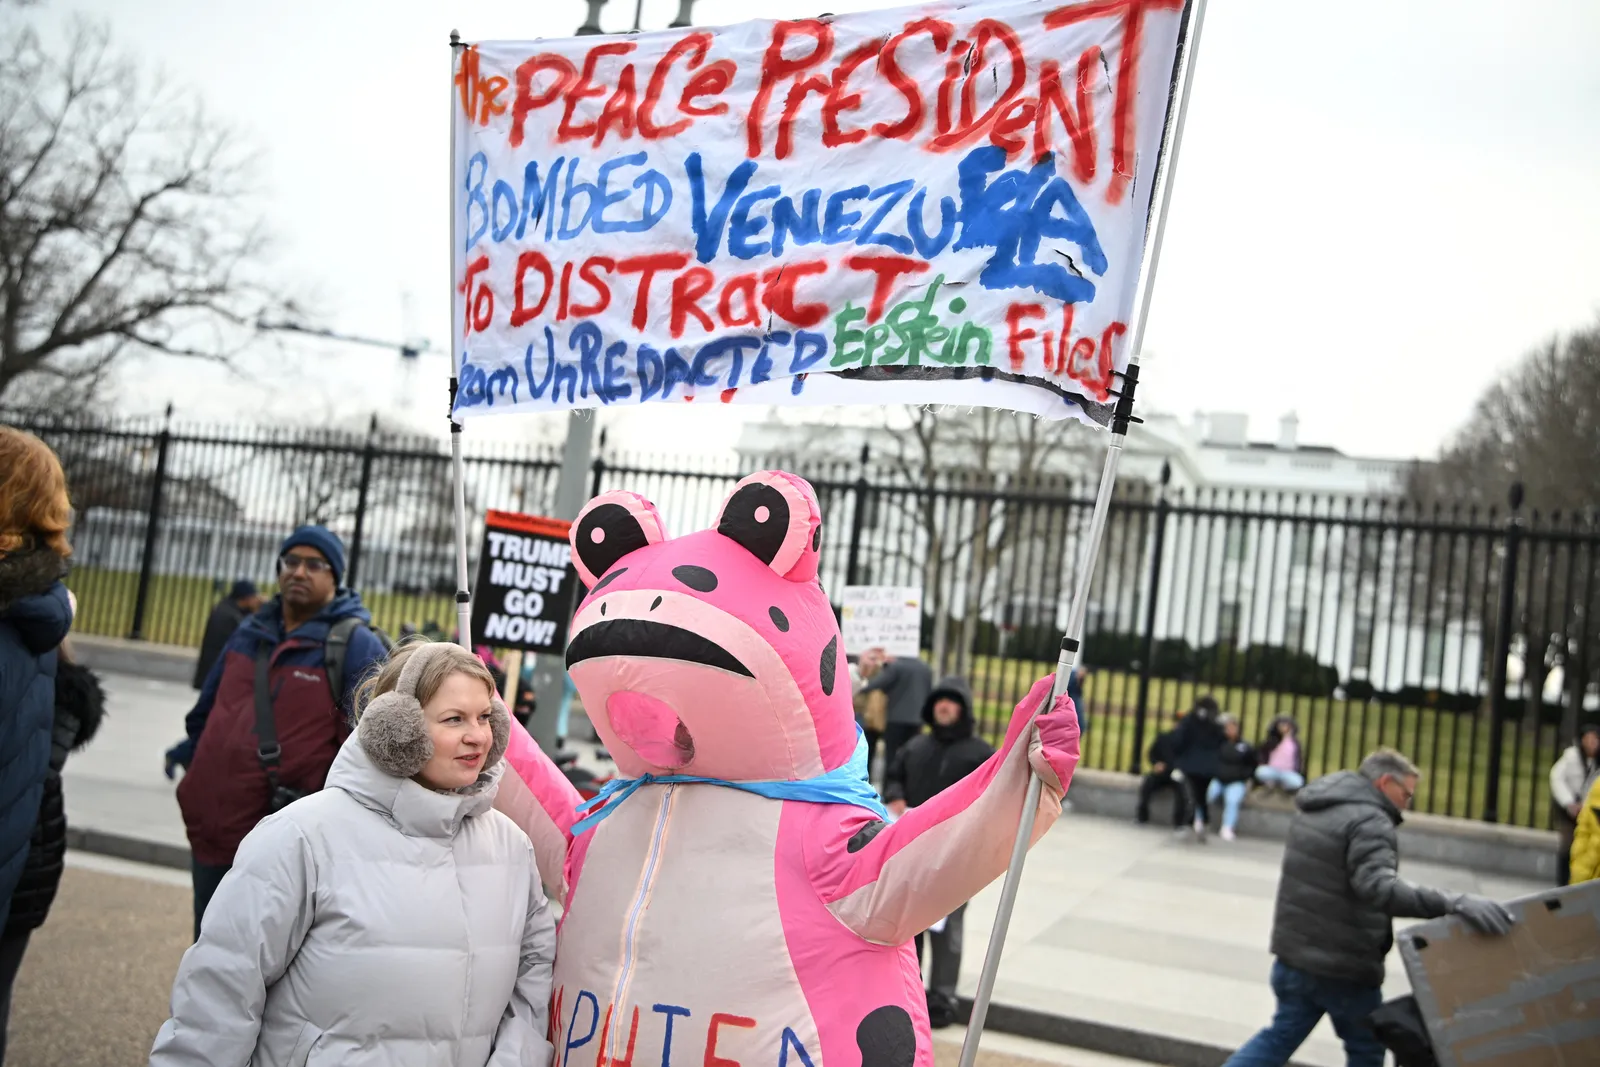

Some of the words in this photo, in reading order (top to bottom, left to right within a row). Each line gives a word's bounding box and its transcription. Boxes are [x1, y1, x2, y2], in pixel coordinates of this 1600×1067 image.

[487, 531, 572, 569] TRUMP
[489, 559, 566, 594] MUST
[503, 588, 545, 618] GO
[484, 612, 558, 646] NOW!
